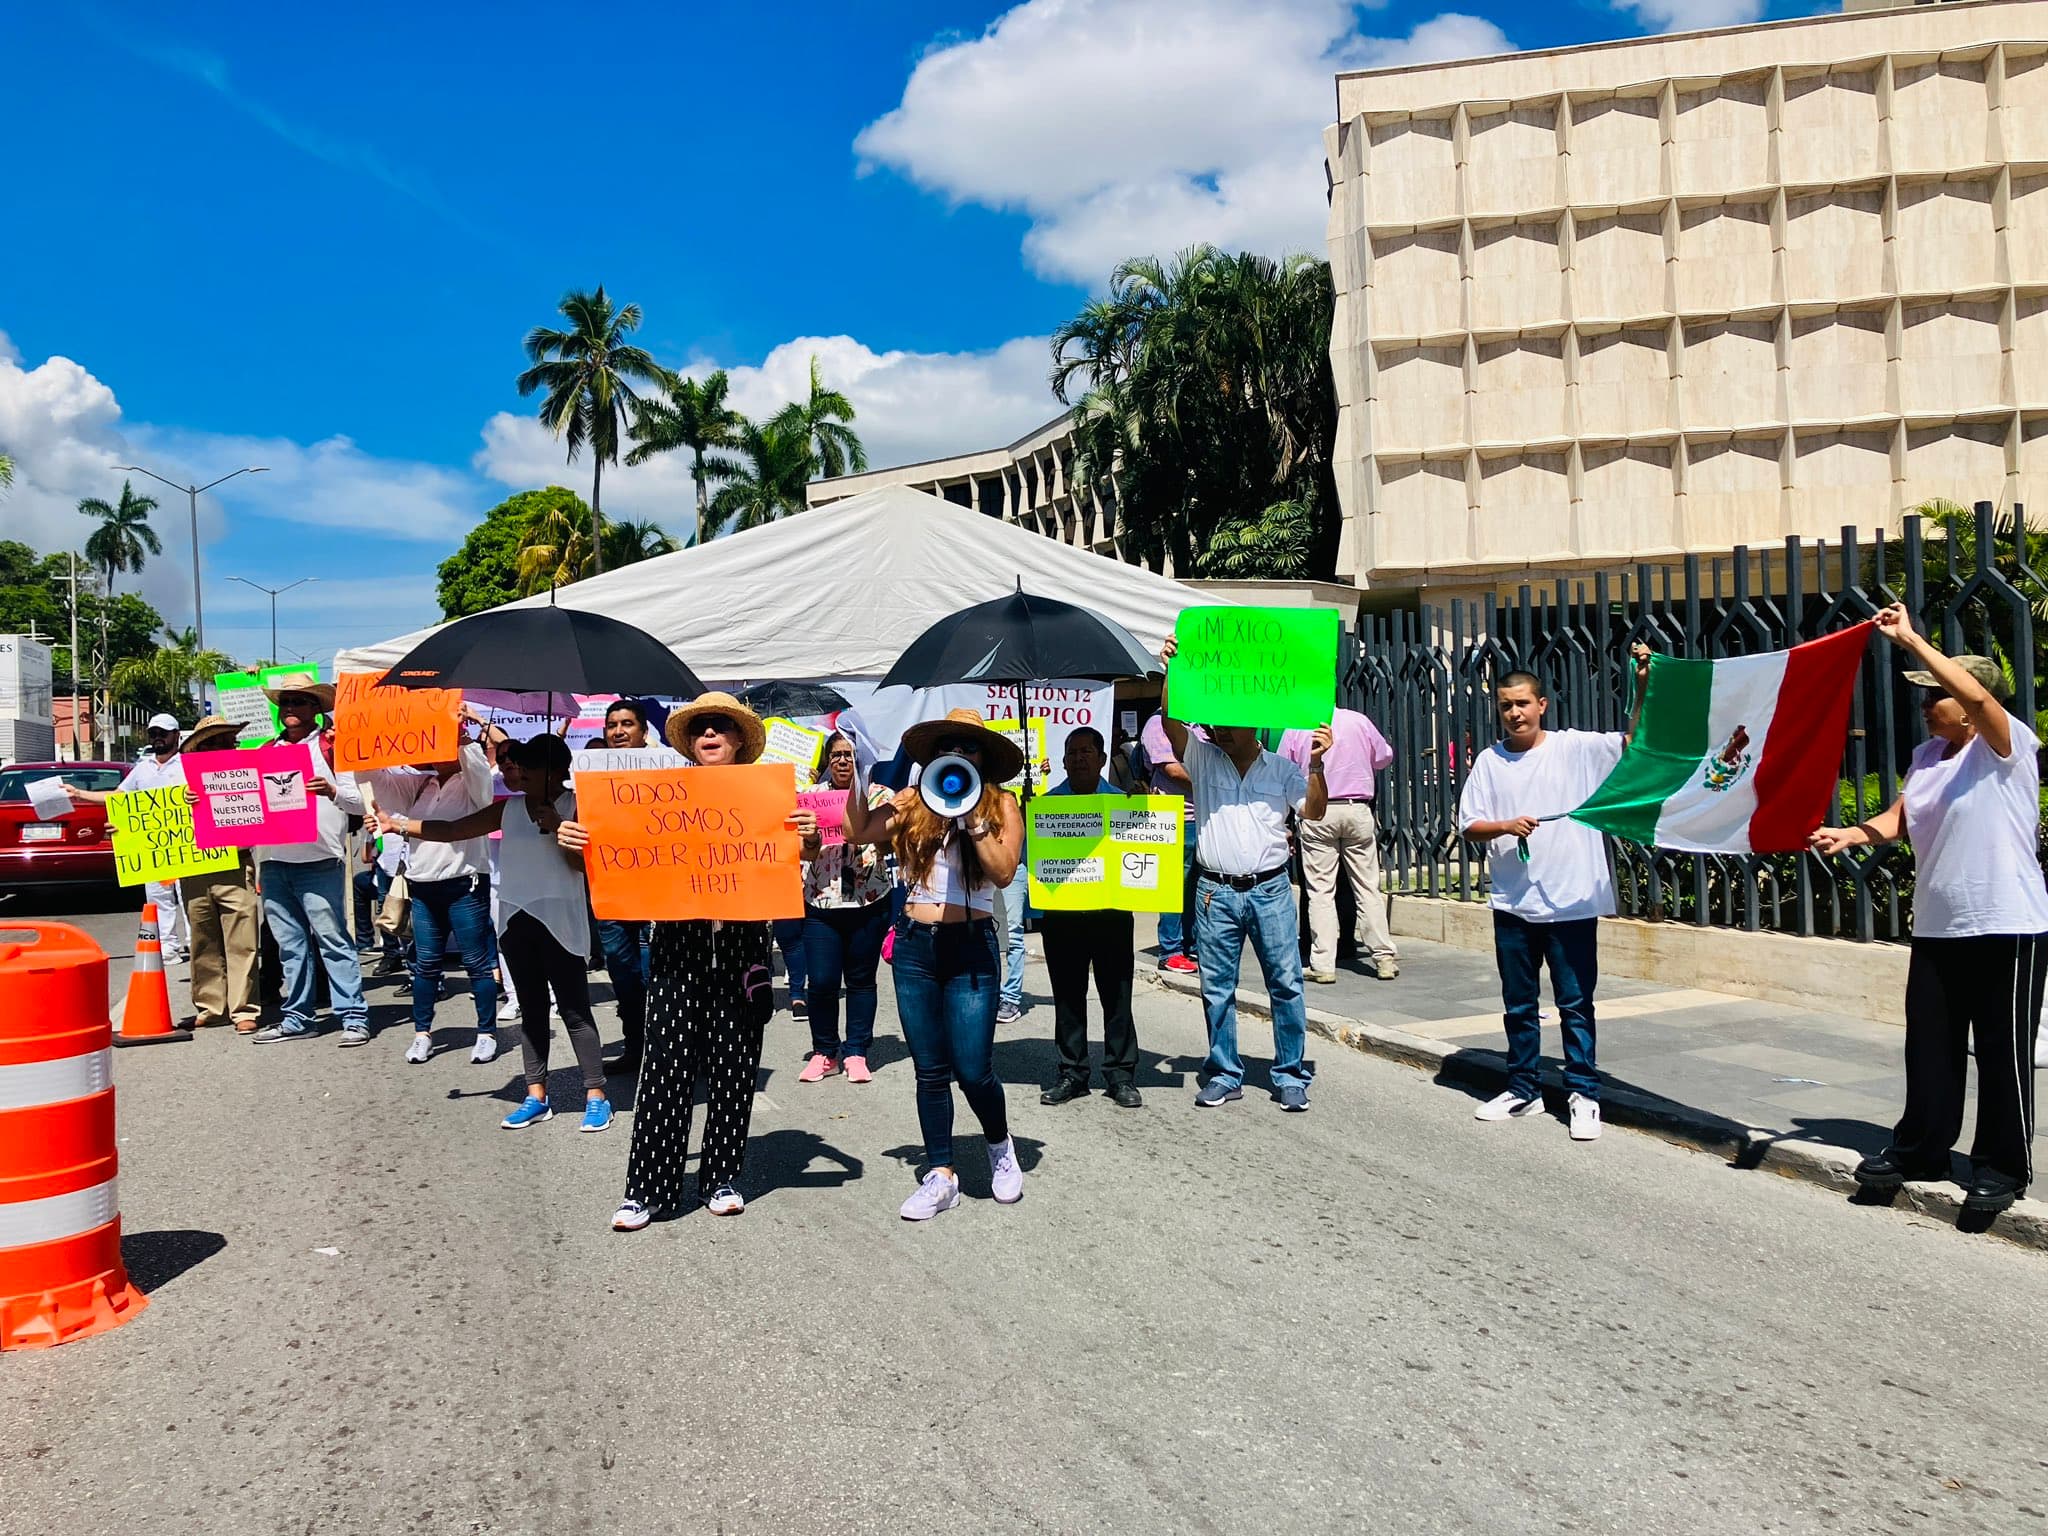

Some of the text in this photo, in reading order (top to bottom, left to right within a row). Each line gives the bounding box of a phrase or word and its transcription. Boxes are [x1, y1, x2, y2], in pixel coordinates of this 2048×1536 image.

[1184, 648, 1288, 670] SOMOS TU
[1074, 689, 1091, 703] 12
[338, 705, 411, 733] CON UN
[490, 714, 522, 725] sirve
[526, 714, 538, 724] el
[229, 769, 249, 779] SON
[203, 780, 258, 792] PRIVILEGIOS
[603, 777, 687, 805] TODOS
[224, 793, 244, 803] SON
[213, 804, 260, 815] NUESTROS
[1071, 812, 1103, 820] JUDICIAL
[647, 807, 743, 837] SOMOS
[1057, 821, 1103, 829] FEDERACIÓN
[1110, 821, 1177, 831] DEFENDER TUS
[1115, 832, 1165, 842] DERECHOS
[116, 843, 229, 873] TU DEFENSA
[598, 841, 784, 871] PODER JUDICIAL
[1060, 858, 1076, 866] NOS
[1043, 867, 1096, 875] DEFENDERNOS
